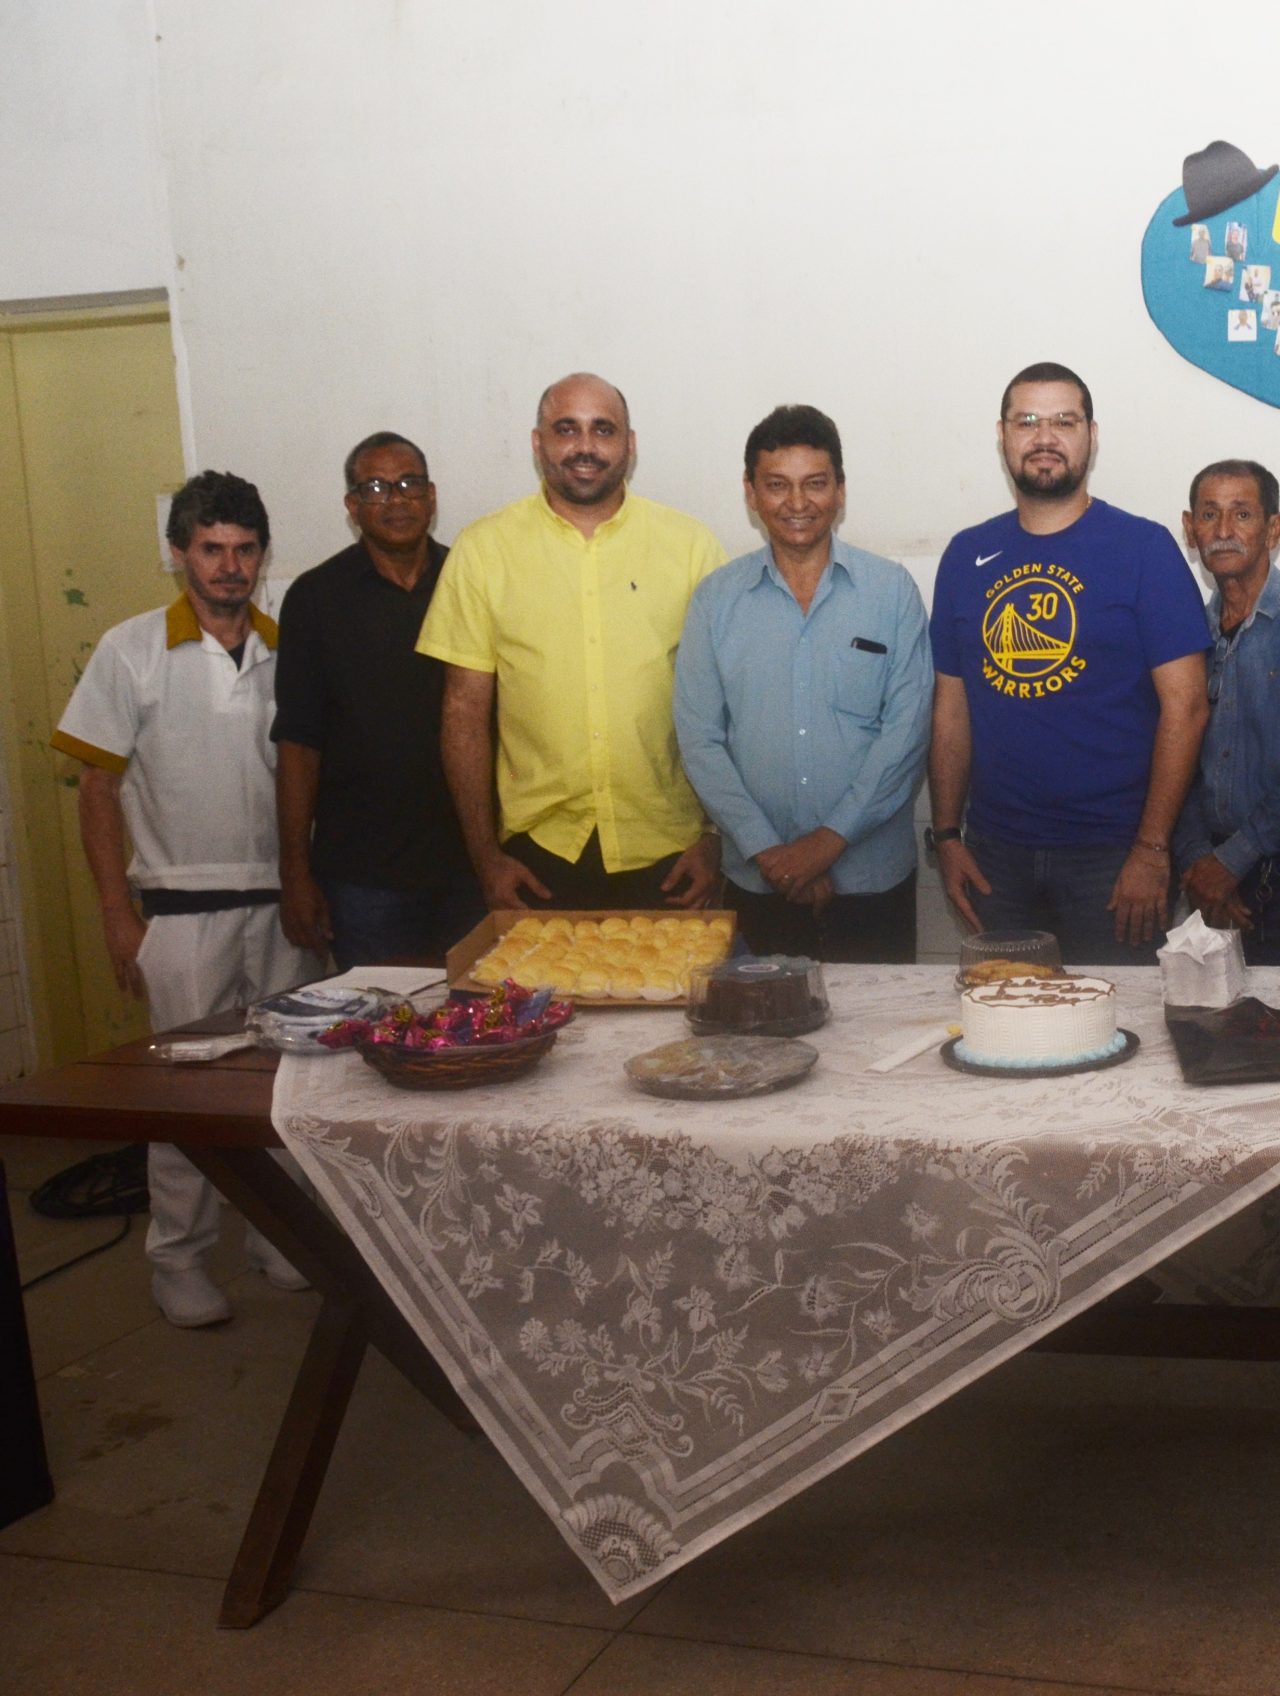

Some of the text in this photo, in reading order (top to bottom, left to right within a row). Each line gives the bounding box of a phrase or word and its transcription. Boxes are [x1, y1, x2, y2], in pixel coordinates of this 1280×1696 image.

[985, 563, 1084, 599] GOLDEN STATE
[1025, 592, 1059, 622] 30
[982, 655, 1087, 699] WARRIORS
